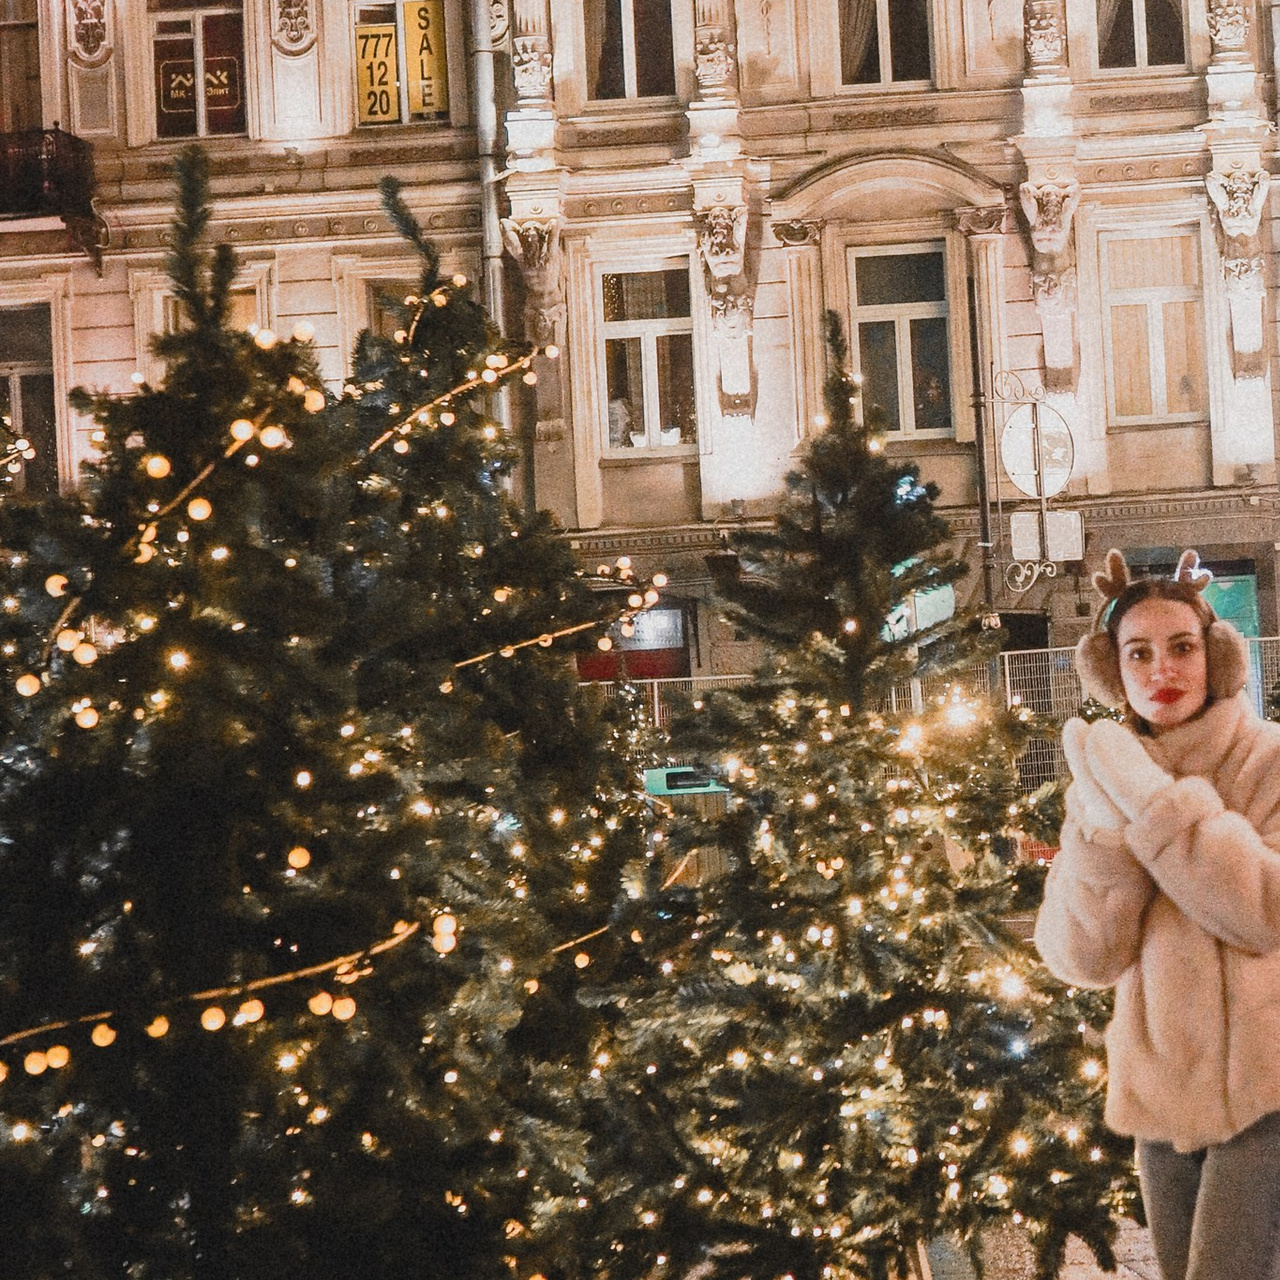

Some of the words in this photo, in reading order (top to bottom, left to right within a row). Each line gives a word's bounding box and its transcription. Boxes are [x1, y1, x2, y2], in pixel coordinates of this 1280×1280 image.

[358, 32, 393, 59] 777
[417, 6, 434, 108] SALE
[366, 60, 389, 87] 12
[367, 89, 390, 116] 20
